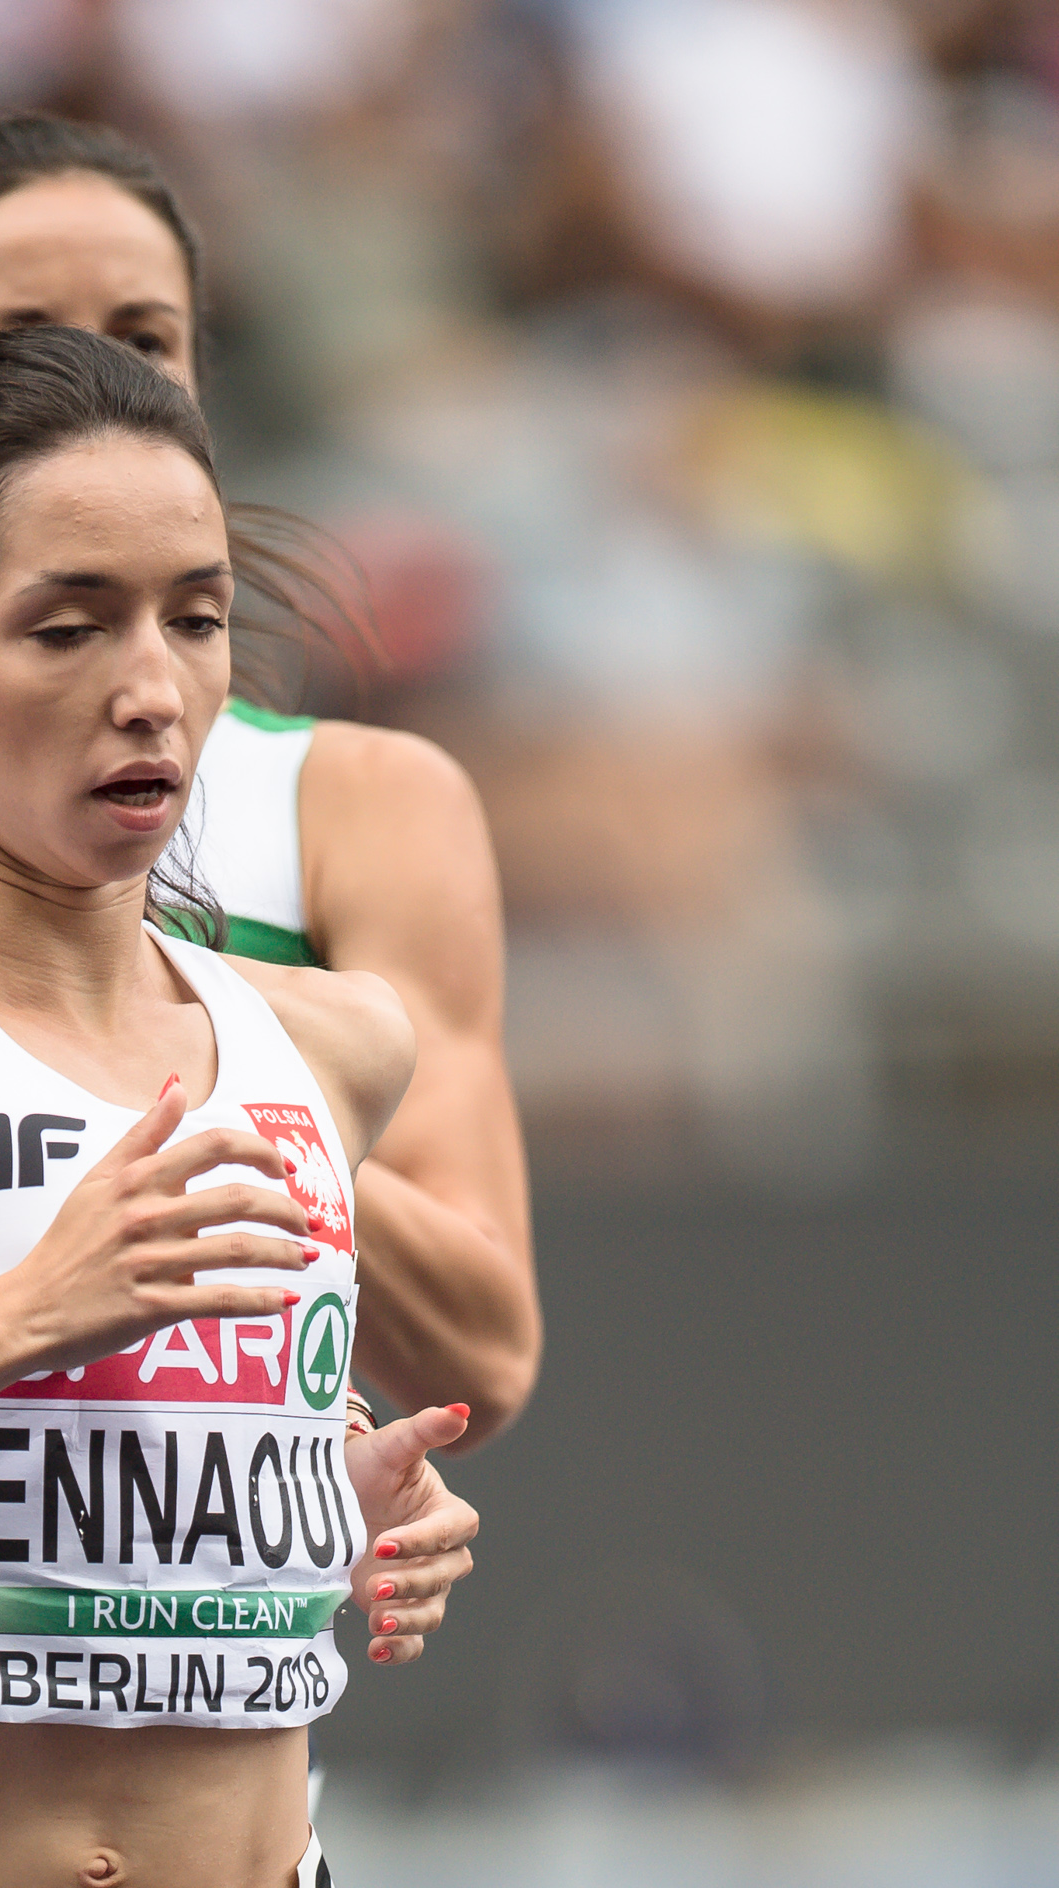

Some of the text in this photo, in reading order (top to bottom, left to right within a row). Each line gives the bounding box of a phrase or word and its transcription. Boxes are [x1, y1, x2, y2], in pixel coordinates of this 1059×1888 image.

[250, 1108, 314, 1129] POLSKA
[16, 1317, 285, 1387] AR
[68, 1595, 75, 1628] I
[93, 1596, 177, 1630] RUN
[244, 1651, 329, 1712] 2018
